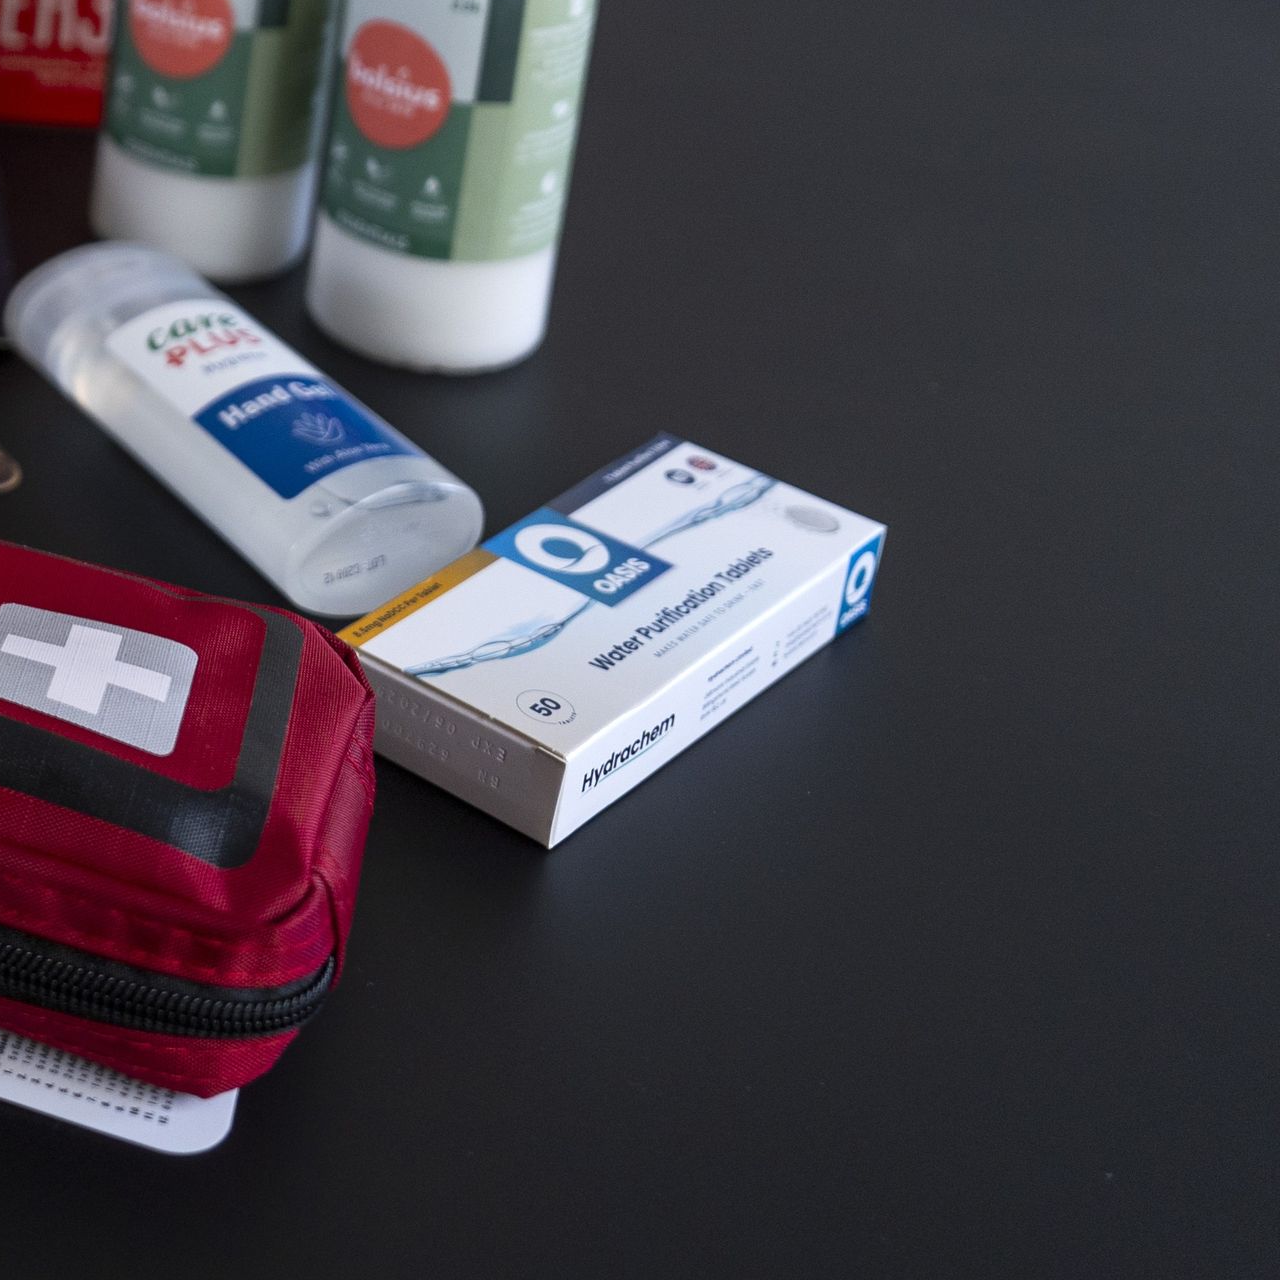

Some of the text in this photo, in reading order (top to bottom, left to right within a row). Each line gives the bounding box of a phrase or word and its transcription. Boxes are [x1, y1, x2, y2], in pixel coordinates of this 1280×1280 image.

[146, 313, 237, 352] care
[163, 328, 262, 367] PLUS
[218, 384, 292, 430] Hand
[593, 556, 652, 595] OASIS
[588, 546, 775, 672] Water Purification Tablets
[530, 696, 561, 718] 50
[581, 712, 676, 794] Hydrachem
